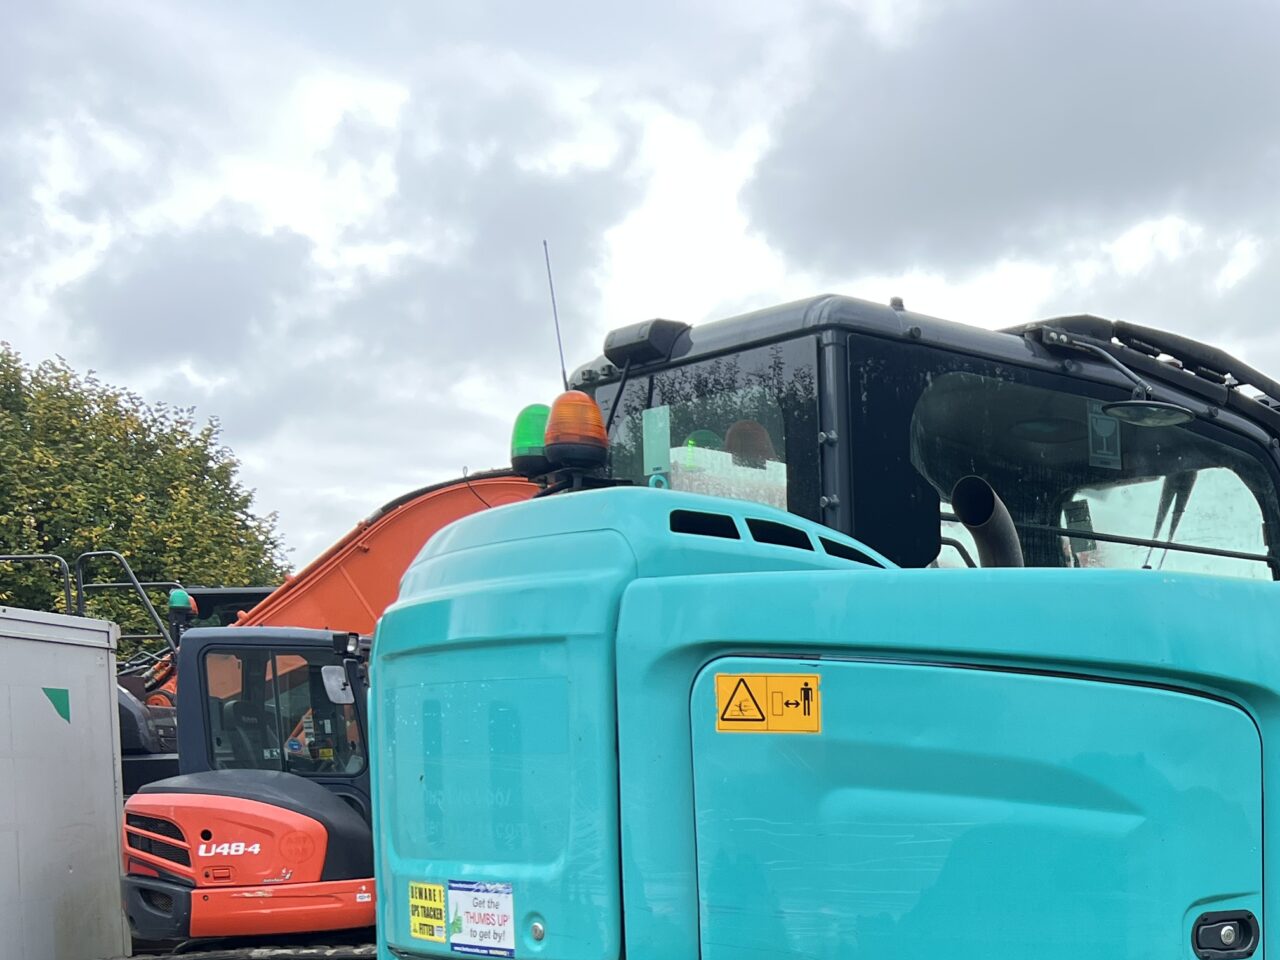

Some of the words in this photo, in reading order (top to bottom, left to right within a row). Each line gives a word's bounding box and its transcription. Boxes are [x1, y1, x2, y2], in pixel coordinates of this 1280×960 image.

[198, 842, 261, 857] U48-4
[472, 897, 486, 908] Get
[487, 899, 500, 909] the
[420, 905, 443, 921] TRACKER
[470, 928, 478, 938] to
[479, 929, 491, 942] get
[493, 930, 506, 943] by!
